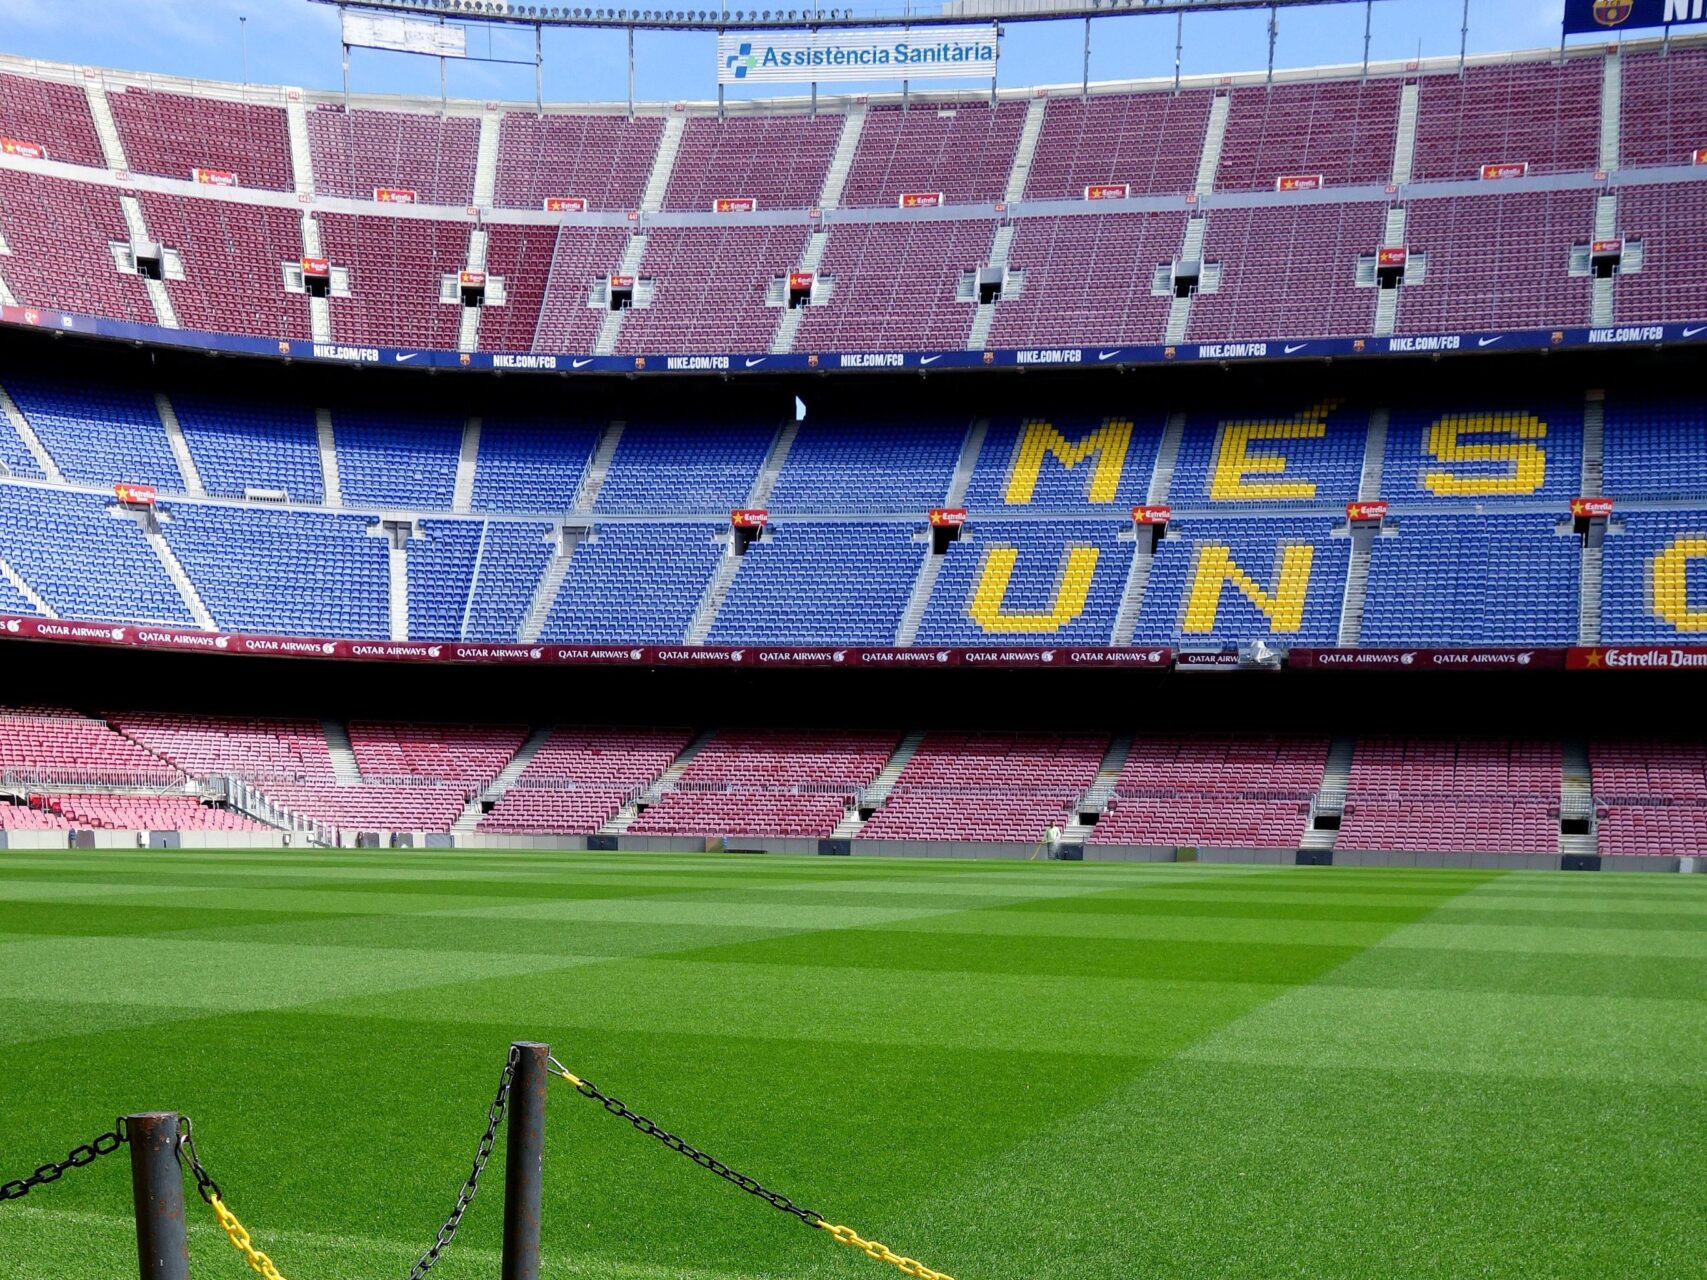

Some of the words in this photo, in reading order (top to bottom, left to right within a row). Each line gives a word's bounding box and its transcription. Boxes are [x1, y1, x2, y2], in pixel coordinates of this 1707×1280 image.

[762, 45, 890, 67] Assistència
[895, 42, 993, 63] Sanitària
[1589, 327, 1663, 343] NIKE.COM/FCB
[1389, 336, 1460, 352] NIKE.COM/FCB
[314, 345, 379, 362] NIKE.COM/FCB
[1017, 349, 1081, 363] NIKE.COM/FCB
[1199, 343, 1266, 358] NIKE.COM/FCB
[493, 354, 556, 368] NIKE.COM/FCB
[667, 356, 729, 369] NIKE.COM/FCB
[840, 353, 903, 367] NIKE.COM/FCB
[1004, 399, 1548, 505] MÉS
[129, 488, 154, 499] Estrella
[1360, 505, 1387, 514] Estrella
[1585, 500, 1612, 511] Estrella
[744, 513, 768, 521] Estrella
[942, 512, 966, 521] Estrella
[1145, 509, 1170, 518] Estrella
[970, 541, 1316, 634] UN
[38, 625, 69, 636] QATAR
[71, 627, 111, 638] AIRWAYS
[139, 632, 171, 643] QATAR
[173, 635, 213, 645] AIRWAYS
[246, 639, 278, 650] QATAR
[280, 642, 320, 652] AIRWAYS
[352, 645, 385, 655] QATAR
[386, 647, 427, 656] AIRWAYS
[457, 648, 488, 658] QATAR
[490, 649, 528, 658] AIRWAYS
[558, 650, 589, 659] QATAR
[591, 651, 631, 659] AIRWAYS
[658, 652, 689, 660] QATAR
[690, 652, 729, 660] AIRWAYS
[759, 652, 791, 661] QATAR
[793, 652, 831, 661] AIRWAYS
[862, 653, 893, 662] QATAR
[895, 653, 934, 661] AIRWAYS
[966, 653, 997, 662] QATAR
[999, 653, 1039, 661] AIRWAYS
[1071, 653, 1103, 662] QATAR
[1106, 653, 1146, 661] AIRWAYS
[1604, 650, 1668, 667] Estrella
[1188, 655, 1215, 663] QATAR
[1319, 655, 1354, 664] QATAR
[1355, 655, 1399, 663] AIRWAYS
[1433, 655, 1469, 664] QATAR
[1471, 655, 1516, 663] AIRWAYS
